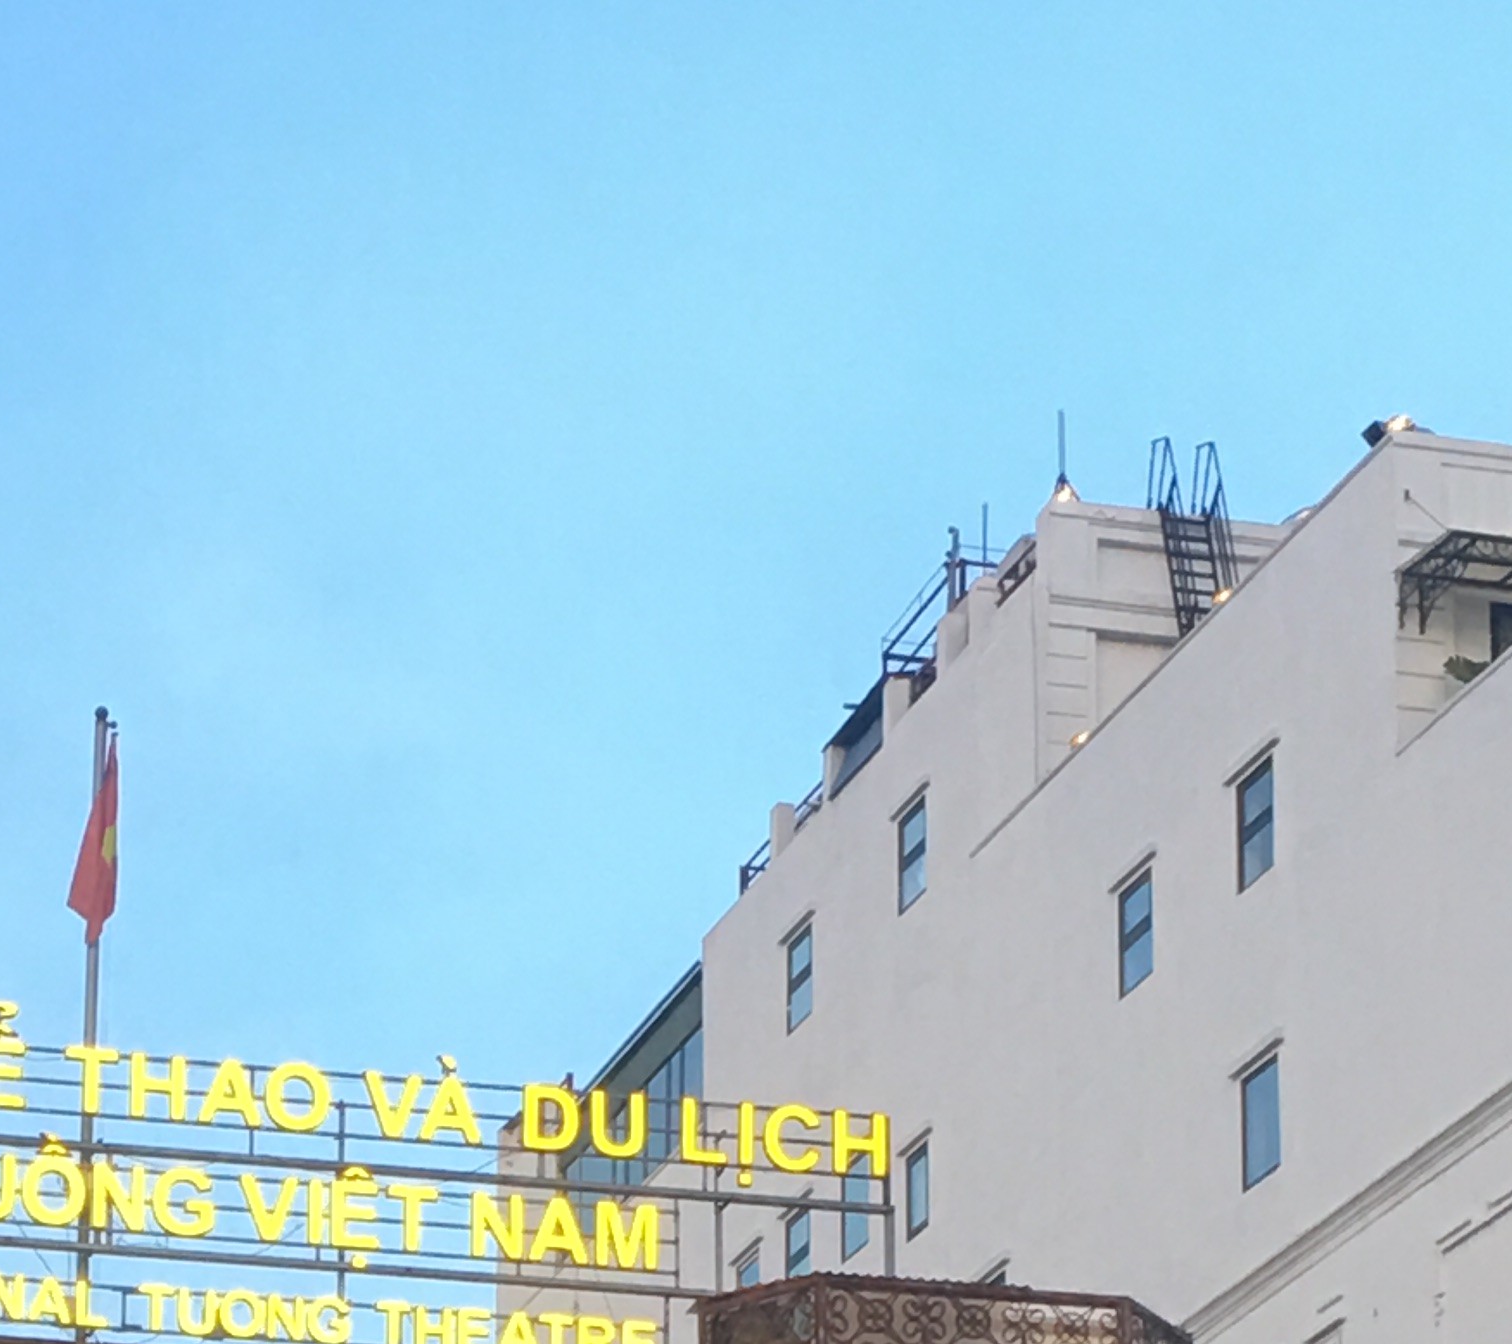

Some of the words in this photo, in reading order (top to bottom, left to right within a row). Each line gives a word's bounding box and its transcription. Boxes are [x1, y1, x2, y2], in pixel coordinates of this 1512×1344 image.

[64, 1045, 332, 1131] THAO
[364, 1055, 481, 1145] VÀ
[522, 1083, 646, 1158] DU
[680, 1096, 888, 1187] LỊCH
[239, 1166, 438, 1270] VIỆT
[470, 1190, 660, 1270] NAM
[138, 1282, 351, 1344] TUONG
